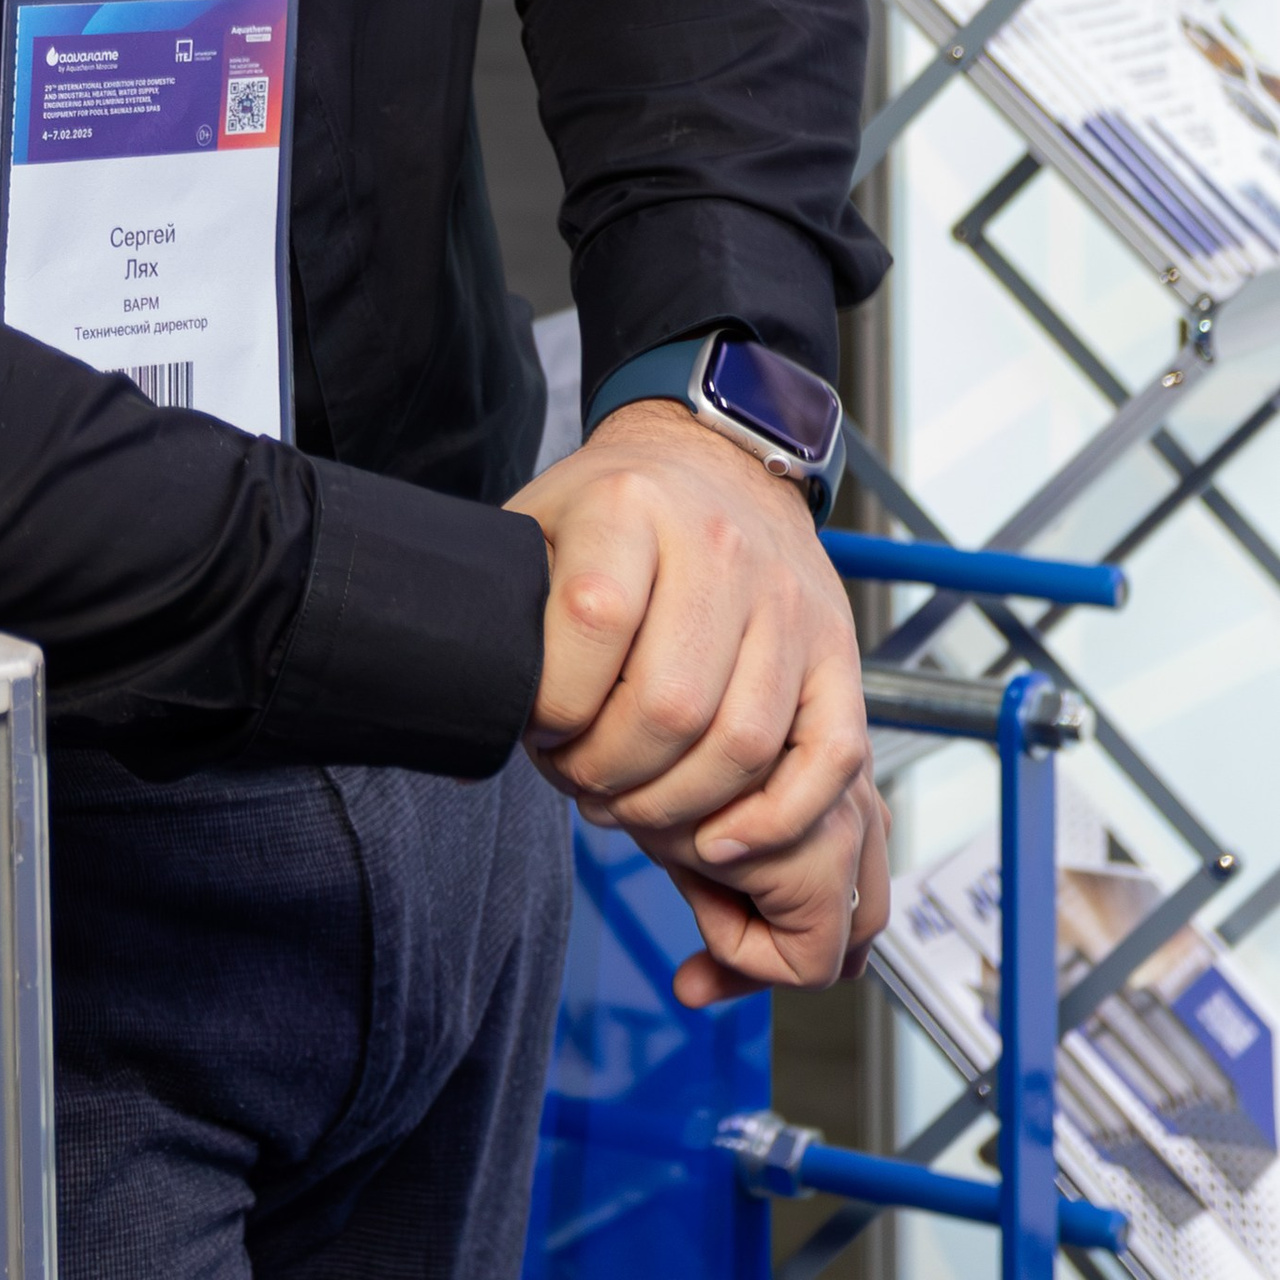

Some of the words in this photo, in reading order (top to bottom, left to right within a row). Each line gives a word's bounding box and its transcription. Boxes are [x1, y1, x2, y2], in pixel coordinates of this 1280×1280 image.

[175, 51, 190, 63] ITE
[135, 79, 146, 87] FOR
[77, 109, 89, 117] FOR
[110, 223, 176, 251] Сергей
[125, 258, 159, 280] Лях
[123, 296, 160, 313] ВАРМ
[74, 320, 151, 341] Технический
[154, 317, 209, 335] директор
